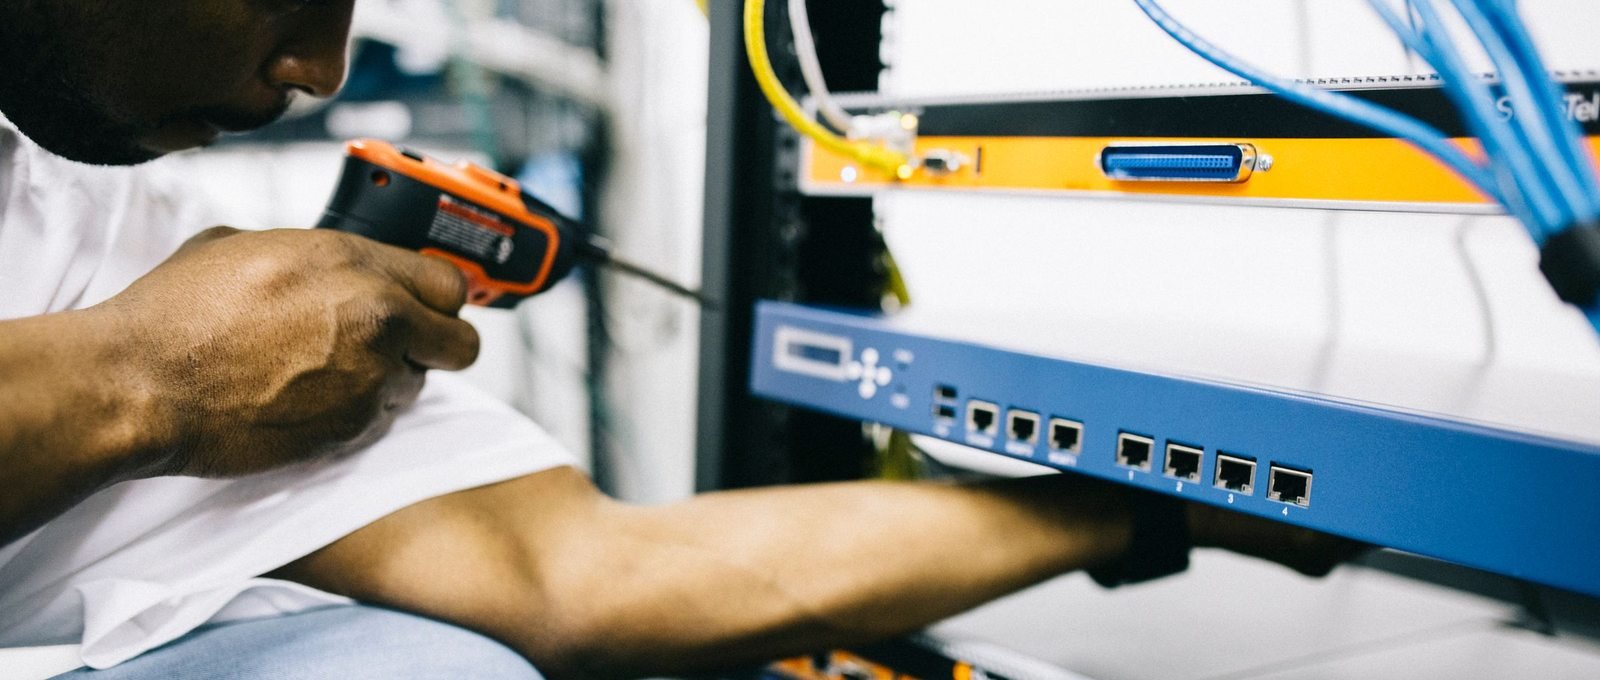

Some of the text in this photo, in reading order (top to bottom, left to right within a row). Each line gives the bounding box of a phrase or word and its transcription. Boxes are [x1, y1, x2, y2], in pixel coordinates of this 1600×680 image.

[1175, 481, 1184, 493] 2
[1227, 493, 1235, 504] 3
[1281, 506, 1289, 517] 4
